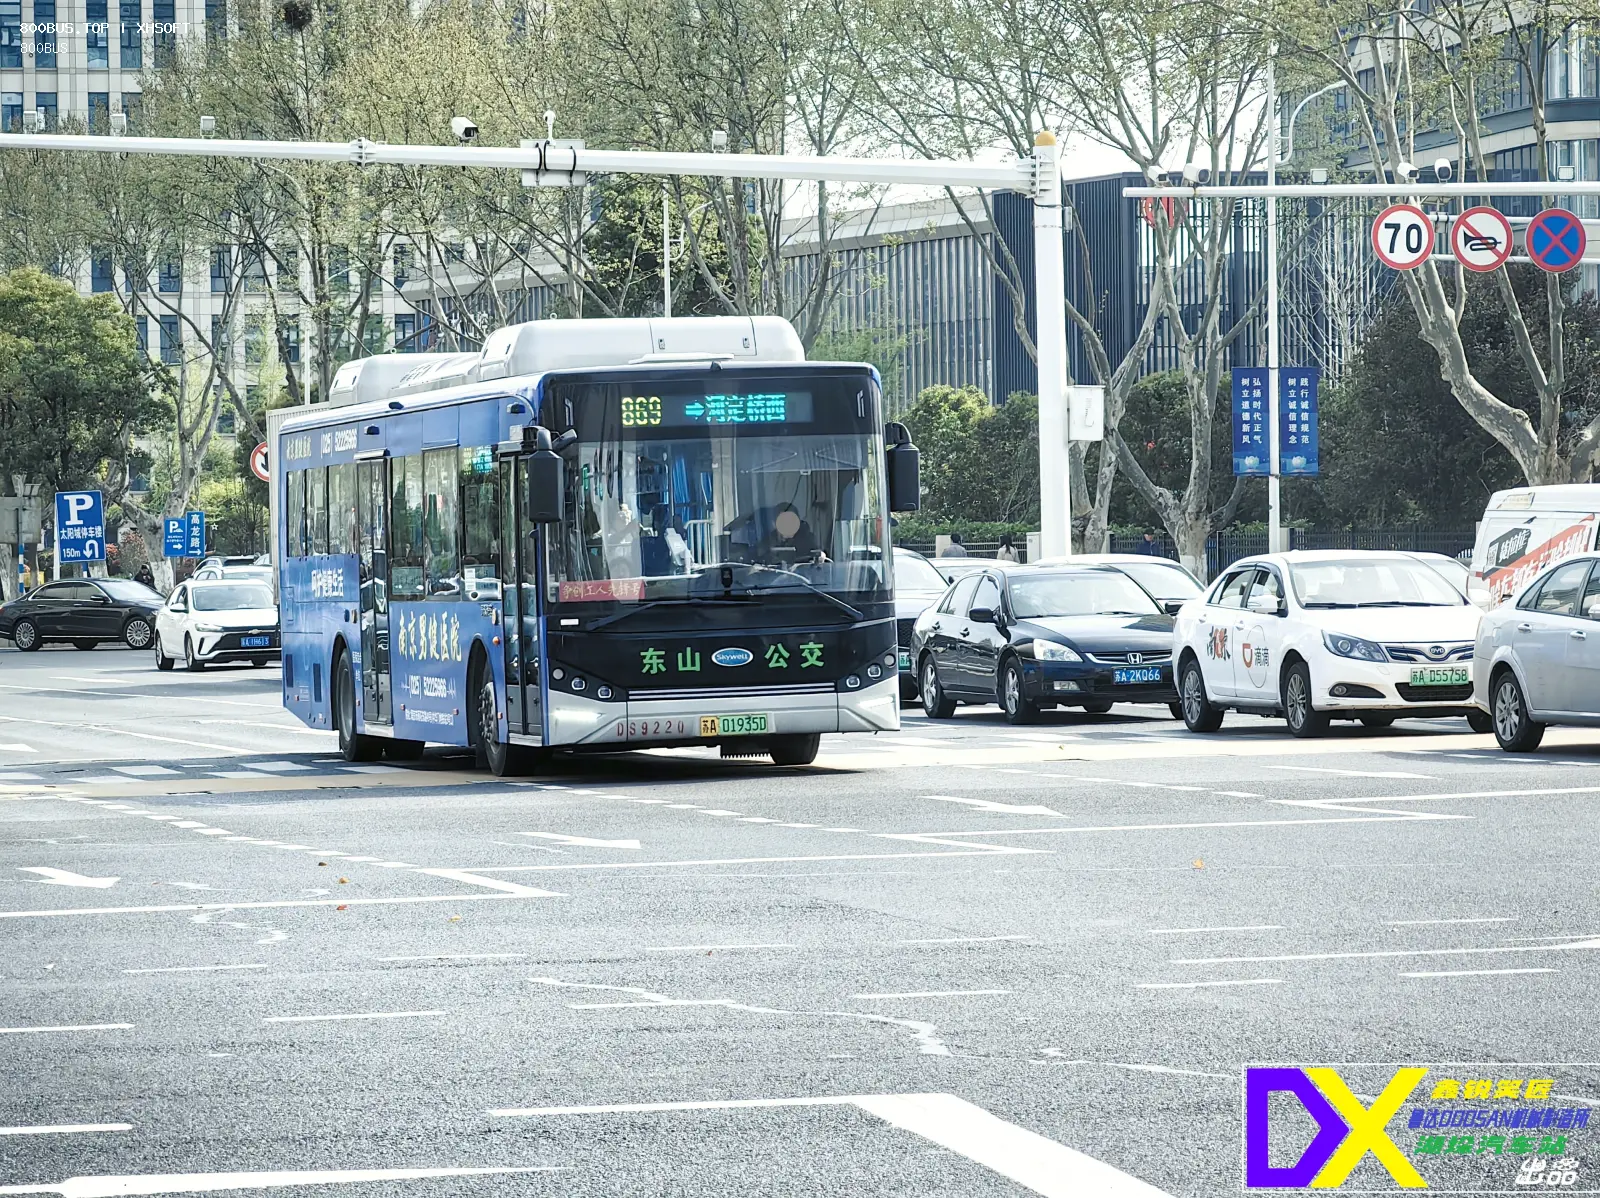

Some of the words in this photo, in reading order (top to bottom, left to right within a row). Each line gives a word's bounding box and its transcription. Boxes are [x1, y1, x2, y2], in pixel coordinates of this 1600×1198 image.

[1384, 223, 1422, 253] 70
[622, 397, 661, 425] 869
[1241, 377, 1251, 444] 树立道德新风
[1252, 377, 1262, 444] 弘扬时代正气
[1288, 377, 1298, 444] 树立诚信理念
[1300, 377, 1309, 444] 践行诚信规范
[63, 494, 94, 525] P
[60, 526, 102, 540] 太阳城停车楼
[190, 514, 201, 548] 高龙路
[63, 548, 81, 558] 150m
[563, 583, 641, 600] 争创工人先锋号
[640, 648, 701, 674] 东山
[716, 652, 749, 663] Skywell
[764, 642, 825, 669] 公交
[1254, 646, 1269, 666] 滴滴
[616, 720, 685, 737] DS9220
[722, 716, 767, 733] 01935D
